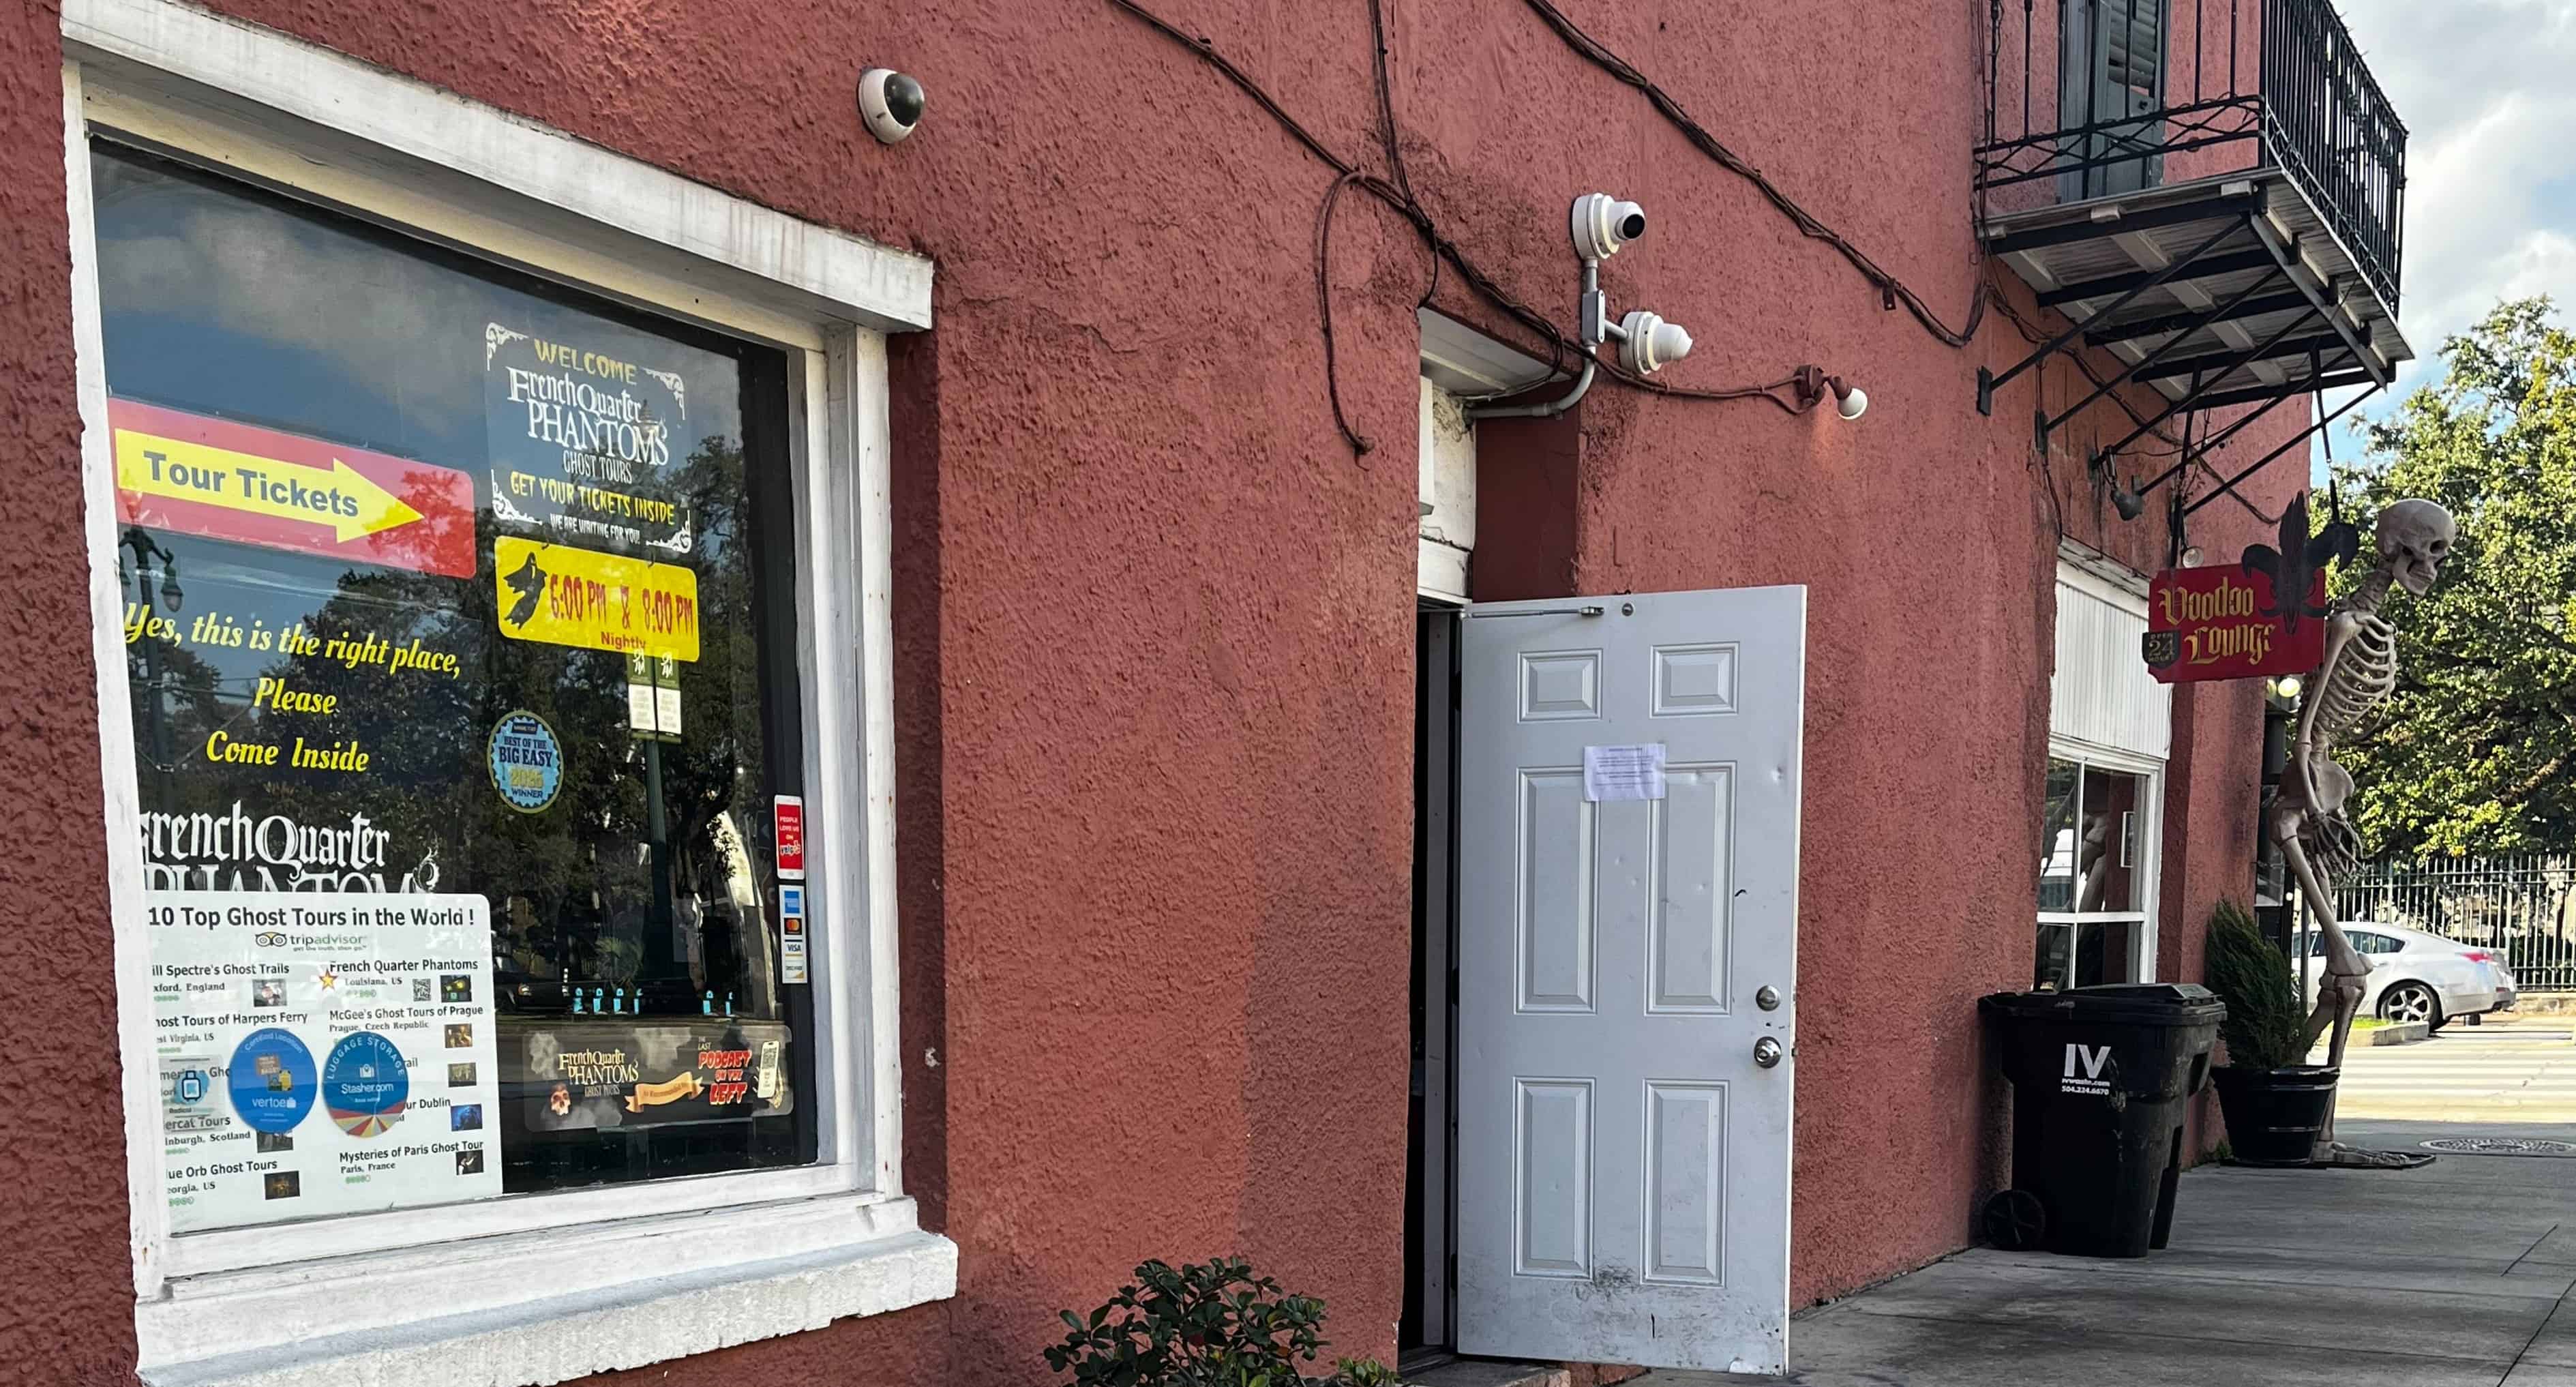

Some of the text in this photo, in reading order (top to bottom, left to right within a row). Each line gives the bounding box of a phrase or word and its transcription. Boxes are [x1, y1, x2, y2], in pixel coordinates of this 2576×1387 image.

[534, 339, 638, 385] WELCOME
[527, 399, 670, 466] PHANTOMS
[563, 450, 633, 484] GHOST TOURS
[143, 450, 359, 517] Tour Tickets
[511, 471, 675, 526] GET YOUR TICKETS INSIDE
[550, 513, 640, 544] WE ARE WAITING FOR YOU!
[550, 573, 583, 622] 6:00
[587, 580, 606, 627] PM
[642, 588, 672, 635] 8:00
[676, 595, 694, 638] PM
[2158, 576, 2254, 626] Voodoo
[124, 602, 462, 678] Yes, this is the right place,
[601, 631, 646, 650] Nightly
[2149, 640, 2174, 656] 24
[2184, 623, 2276, 666] Lounge
[254, 677, 337, 714] Please
[207, 730, 370, 772] Come Inside
[504, 736, 547, 749] BEST OF THE
[499, 747, 553, 767] BIG EASY
[512, 788, 543, 799] WINNER
[149, 907, 174, 926] 10
[181, 906, 221, 929] Top
[227, 906, 286, 927] Ghost
[291, 906, 346, 926] Tours
[353, 906, 371, 925] in
[375, 906, 406, 925] the
[410, 907, 464, 926] World
[289, 934, 363, 946] tripadvisor
[787, 943, 801, 952] VISA
[152, 963, 290, 978] ill Spectre's Ghost Trails
[329, 959, 479, 974] French Quarter Phantoms
[153, 982, 225, 993] xford, England
[391, 976, 403, 985] US
[182, 1014, 215, 1026] Tours
[218, 1013, 230, 1024] of
[233, 1013, 277, 1026] Harpers
[280, 1012, 308, 1024] Ferry
[329, 1006, 483, 1020] McGee's Ghost Tours of Prague
[365, 1022, 390, 1030] Czech
[393, 1021, 429, 1030] Republic
[698, 1042, 711, 1050] LAST
[327, 1037, 363, 1079] LUGGAGE
[367, 1037, 404, 1076] STORAGE
[698, 1049, 752, 1070] PODCAST
[2064, 1043, 2112, 1079] IV
[568, 1059, 639, 1086] PHANTOMS
[252, 1097, 286, 1108] vertoe
[419, 1097, 451, 1109] Dublin
[710, 1082, 748, 1105] LEFT
[164, 1117, 230, 1130] ercat Tours
[209, 1131, 251, 1142] Scotland
[340, 1140, 483, 1162] Mysteries of Paris Ghost Tour
[186, 1166, 207, 1177] Orb
[210, 1162, 243, 1175] Ghost
[245, 1160, 278, 1172] Tours
[340, 1163, 395, 1174] Paris, France
[203, 1181, 215, 1190] US
